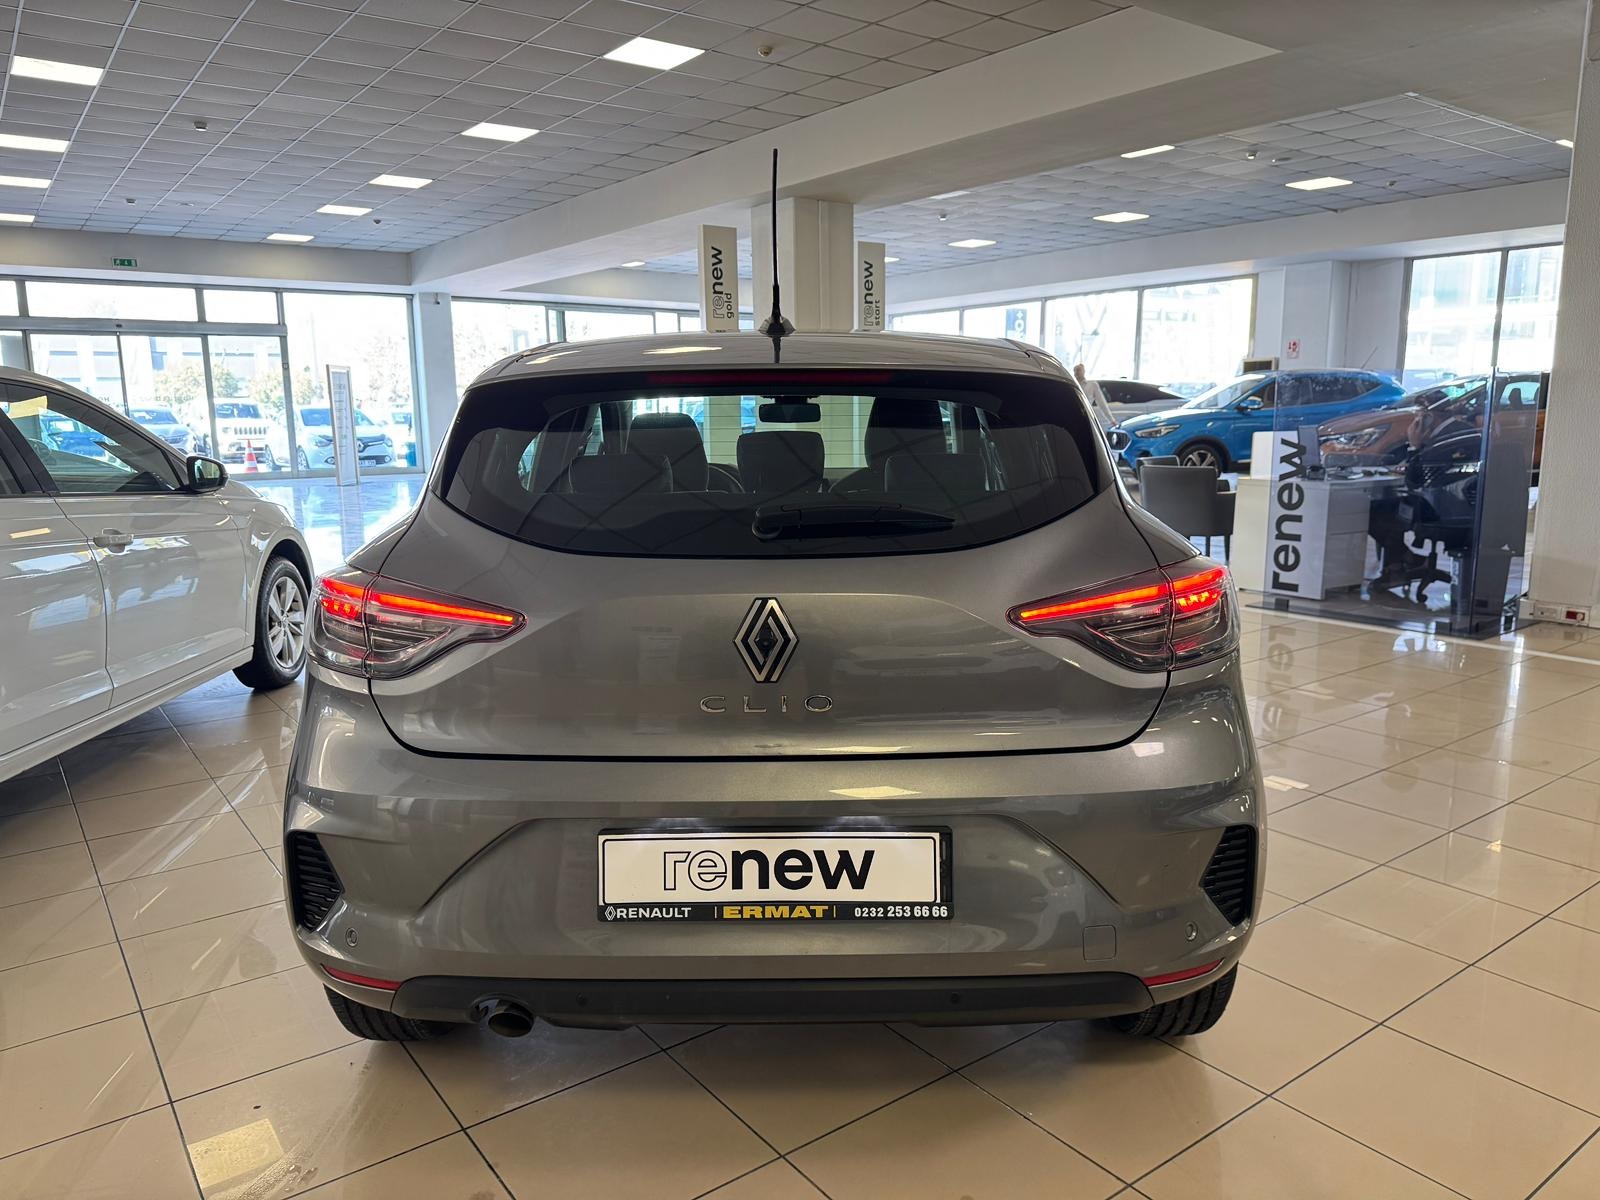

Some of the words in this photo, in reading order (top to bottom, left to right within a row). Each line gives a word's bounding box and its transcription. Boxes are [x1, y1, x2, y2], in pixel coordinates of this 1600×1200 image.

[711, 246, 725, 319] renew
[863, 260, 874, 326] renew
[724, 292, 735, 319] gold
[1271, 437, 1308, 593] renew
[700, 694, 833, 713] CLIO
[663, 849, 876, 891] renew
[616, 906, 692, 919] RENAULT
[722, 905, 829, 919] ERMAT
[854, 906, 884, 918] 0232
[887, 905, 911, 918] 253
[913, 905, 930, 918] 66
[932, 905, 948, 918] 66
